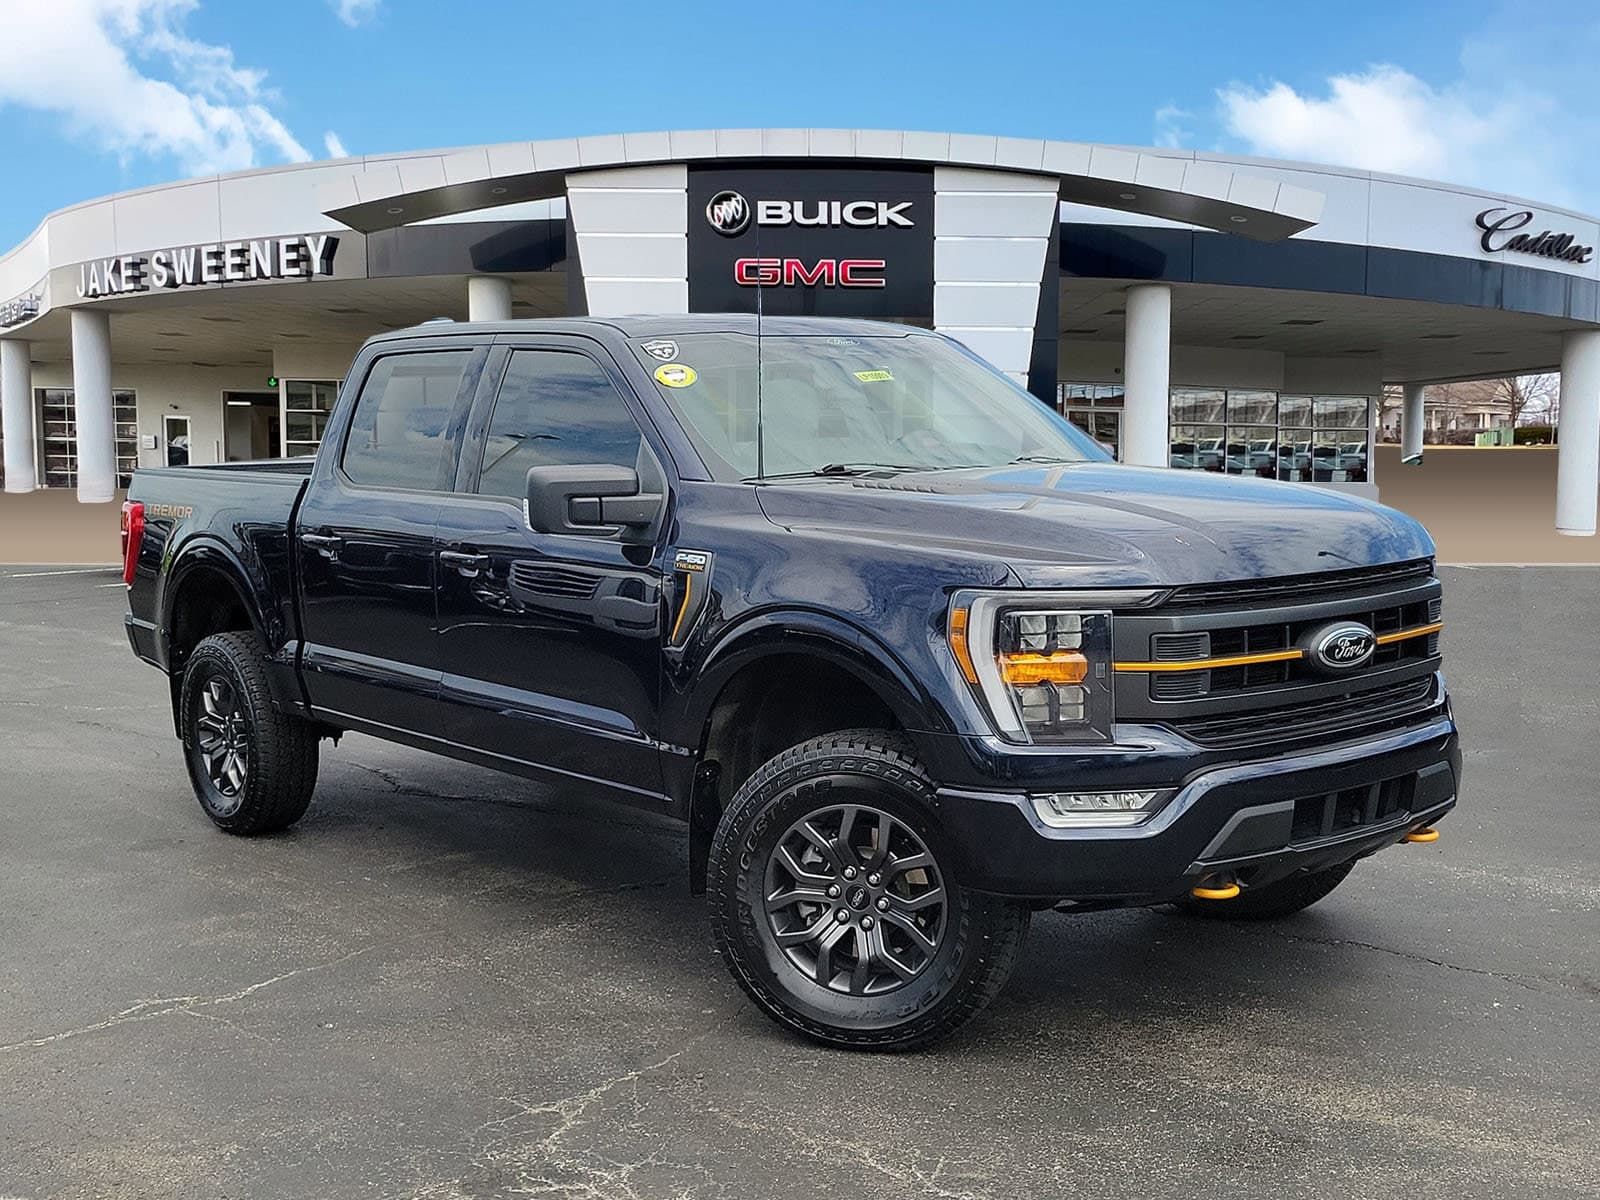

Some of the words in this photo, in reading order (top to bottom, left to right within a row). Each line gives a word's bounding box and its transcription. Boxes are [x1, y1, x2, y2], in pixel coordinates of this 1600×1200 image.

[757, 200, 914, 227] BUICK
[1475, 207, 1593, 264] Cadillac
[77, 256, 143, 297] JAKE
[152, 234, 338, 288] SWEENEY
[734, 257, 886, 287] GMC
[146, 503, 193, 519] TREMOR
[1334, 636, 1366, 660] Ford
